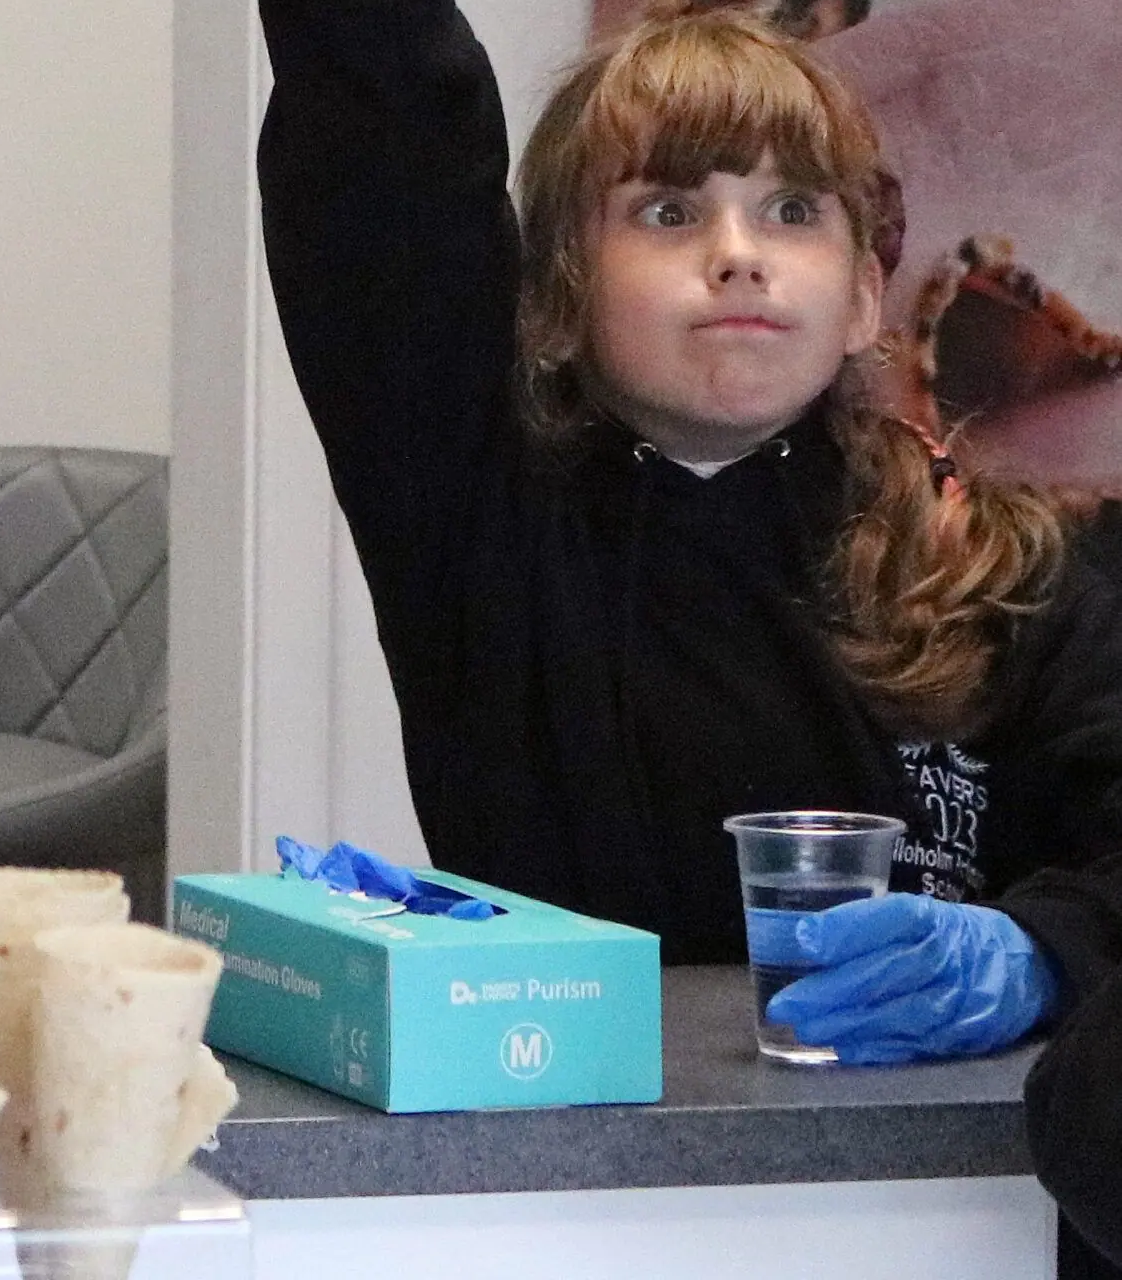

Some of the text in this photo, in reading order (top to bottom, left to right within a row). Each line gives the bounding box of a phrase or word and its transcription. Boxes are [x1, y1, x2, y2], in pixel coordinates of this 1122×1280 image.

[180, 900, 230, 940] Medical
[281, 964, 322, 1001] Gloves
[527, 977, 601, 1001] Purism
[510, 1033, 543, 1068] M
